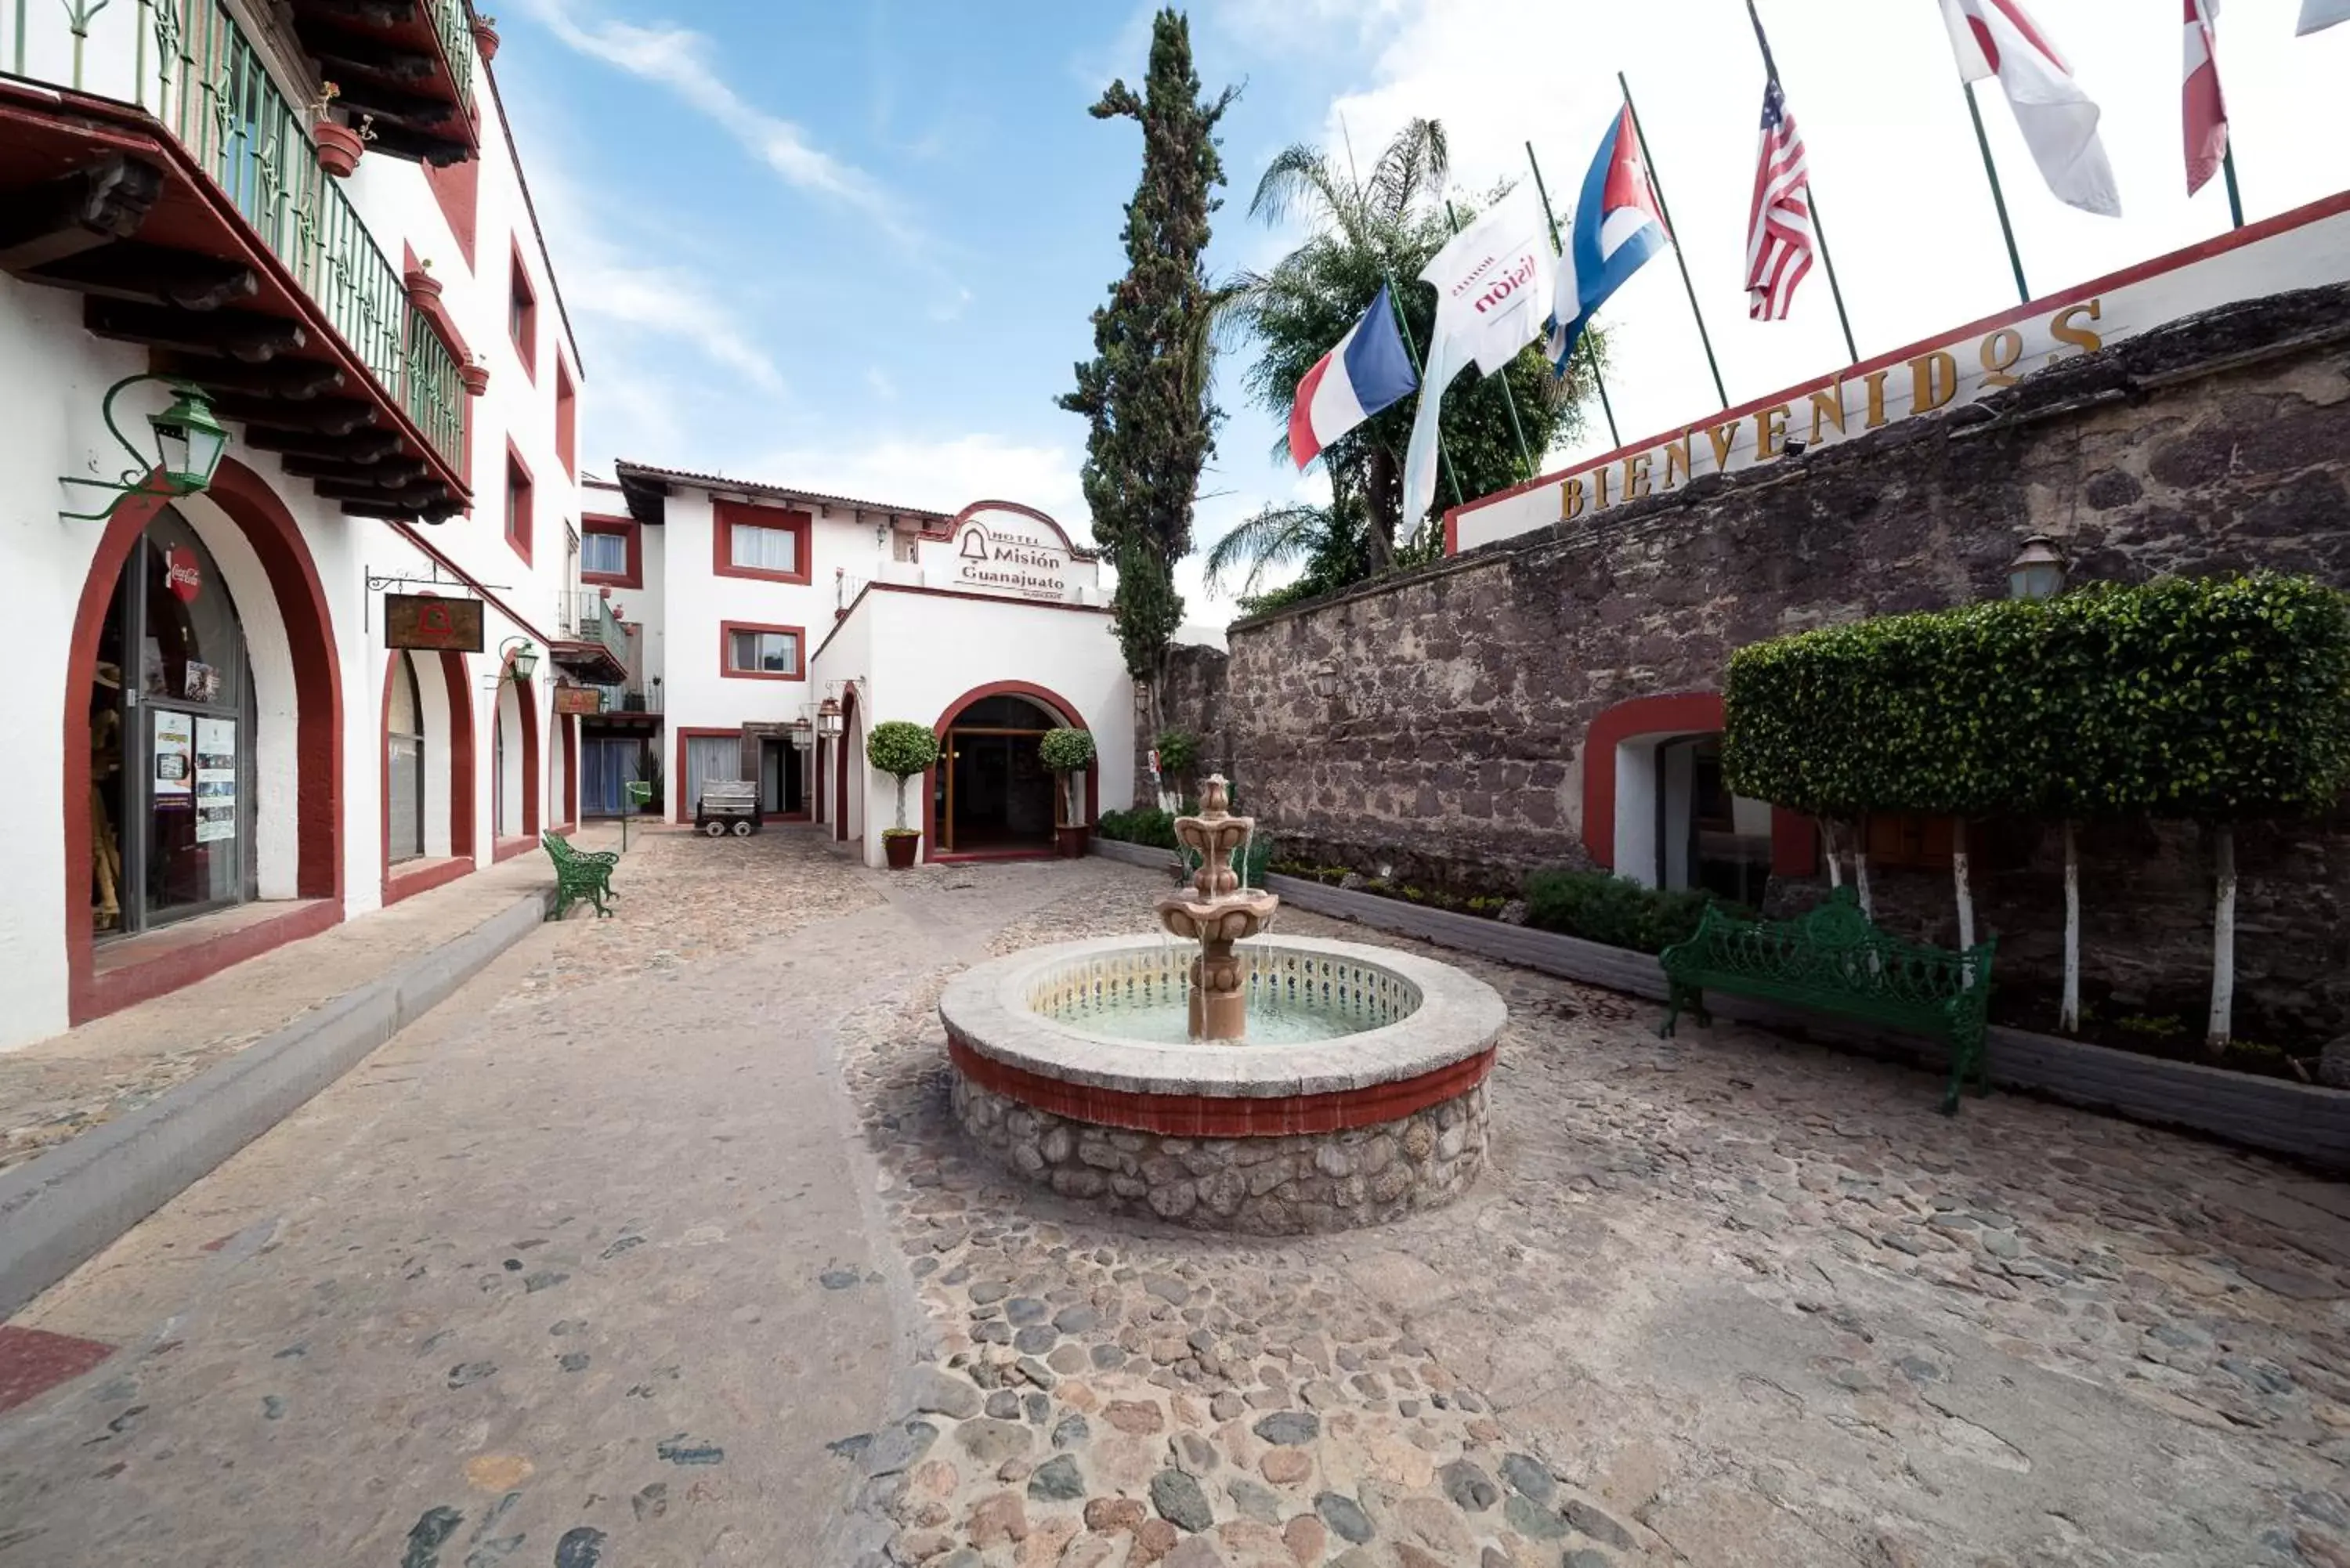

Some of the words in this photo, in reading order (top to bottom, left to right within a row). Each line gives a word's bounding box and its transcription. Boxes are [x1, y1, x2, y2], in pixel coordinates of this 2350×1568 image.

[992, 532, 1039, 544] HOTEL
[993, 547, 1061, 569] Misión
[962, 565, 1065, 590] Guanajuato
